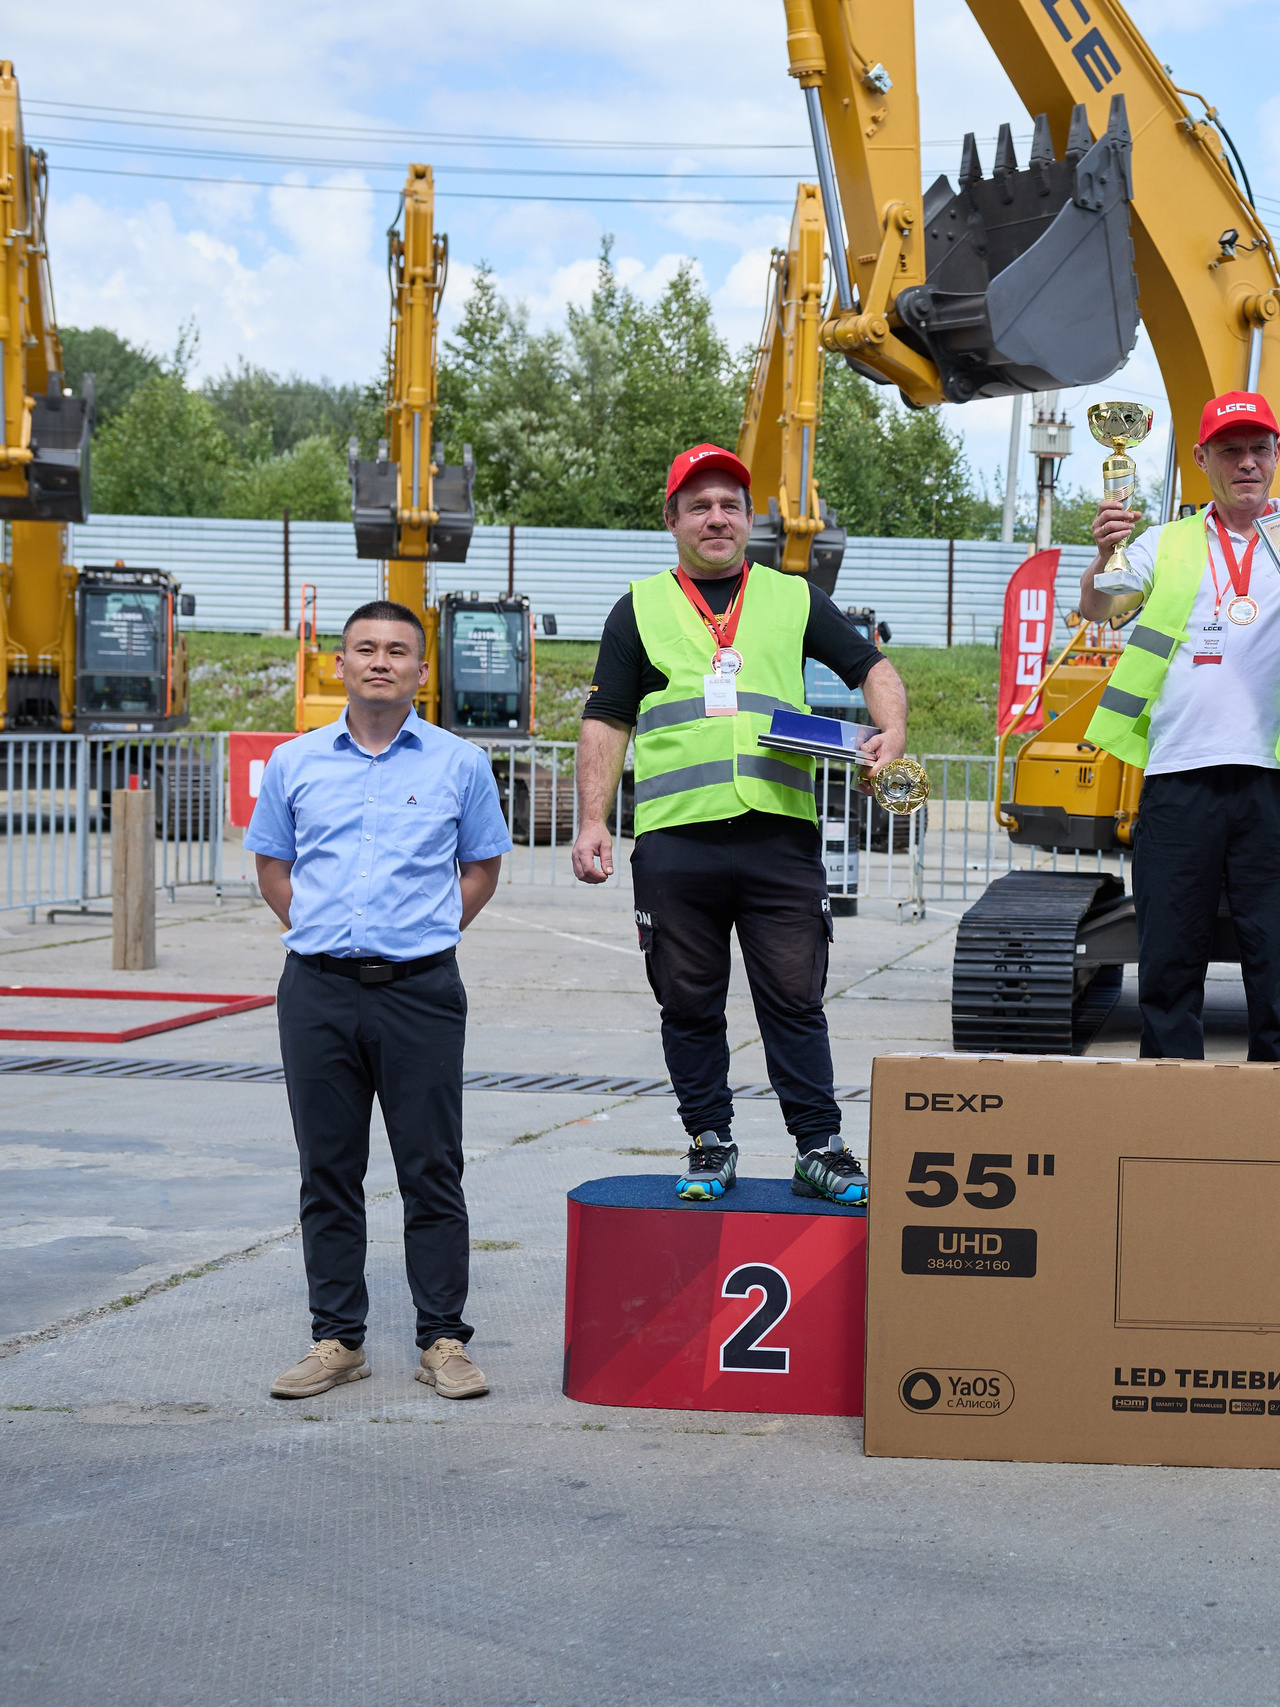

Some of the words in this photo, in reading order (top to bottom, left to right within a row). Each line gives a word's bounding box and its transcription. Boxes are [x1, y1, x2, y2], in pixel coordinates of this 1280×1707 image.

[1217, 402, 1257, 416] LGCE
[1011, 589, 1047, 715] LGCE
[904, 1092, 1004, 1113] DEXP
[938, 1232, 1003, 1255] UHD
[719, 1262, 791, 1374] 2
[948, 1376, 1000, 1397] YaOS
[1114, 1367, 1166, 1387] LED
[956, 1397, 1000, 1409] Алисой
